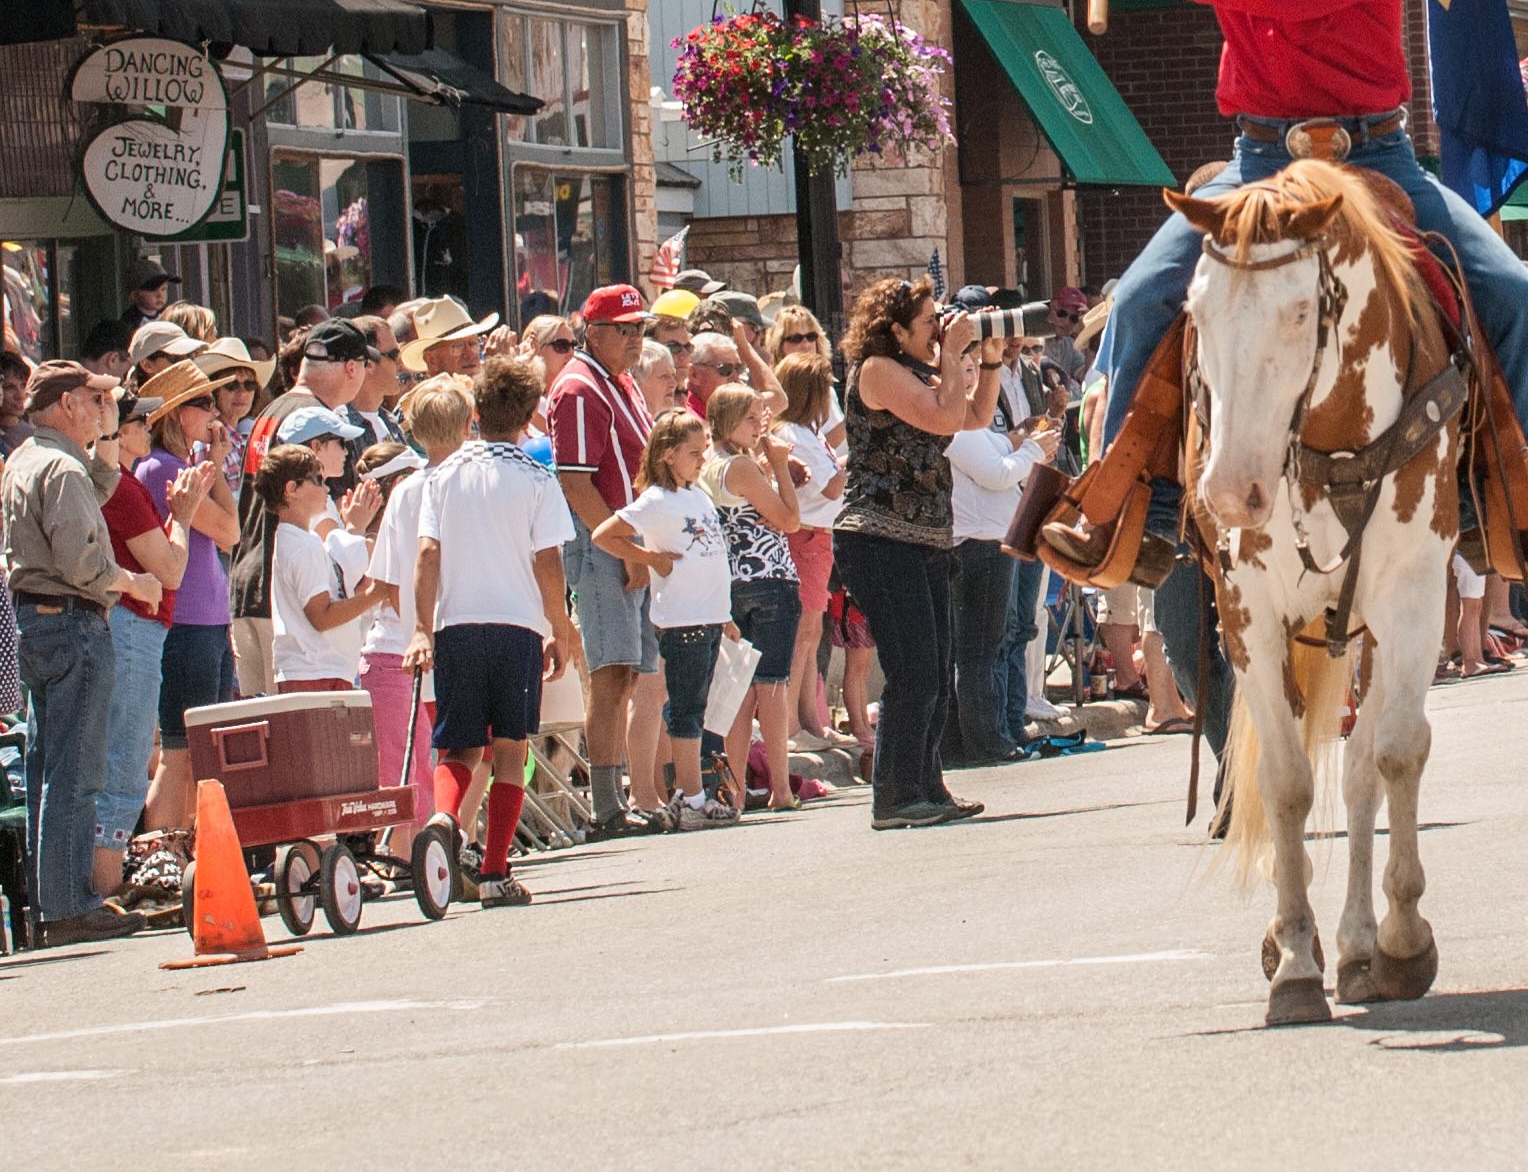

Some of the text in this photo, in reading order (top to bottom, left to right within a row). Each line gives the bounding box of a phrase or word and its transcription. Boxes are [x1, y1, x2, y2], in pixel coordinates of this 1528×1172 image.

[104, 48, 203, 78] DANCING
[104, 74, 204, 103] WILLOW
[111, 136, 201, 167] JEWELRY,
[105, 160, 207, 190] CLOTHING,
[143, 183, 156, 199] &
